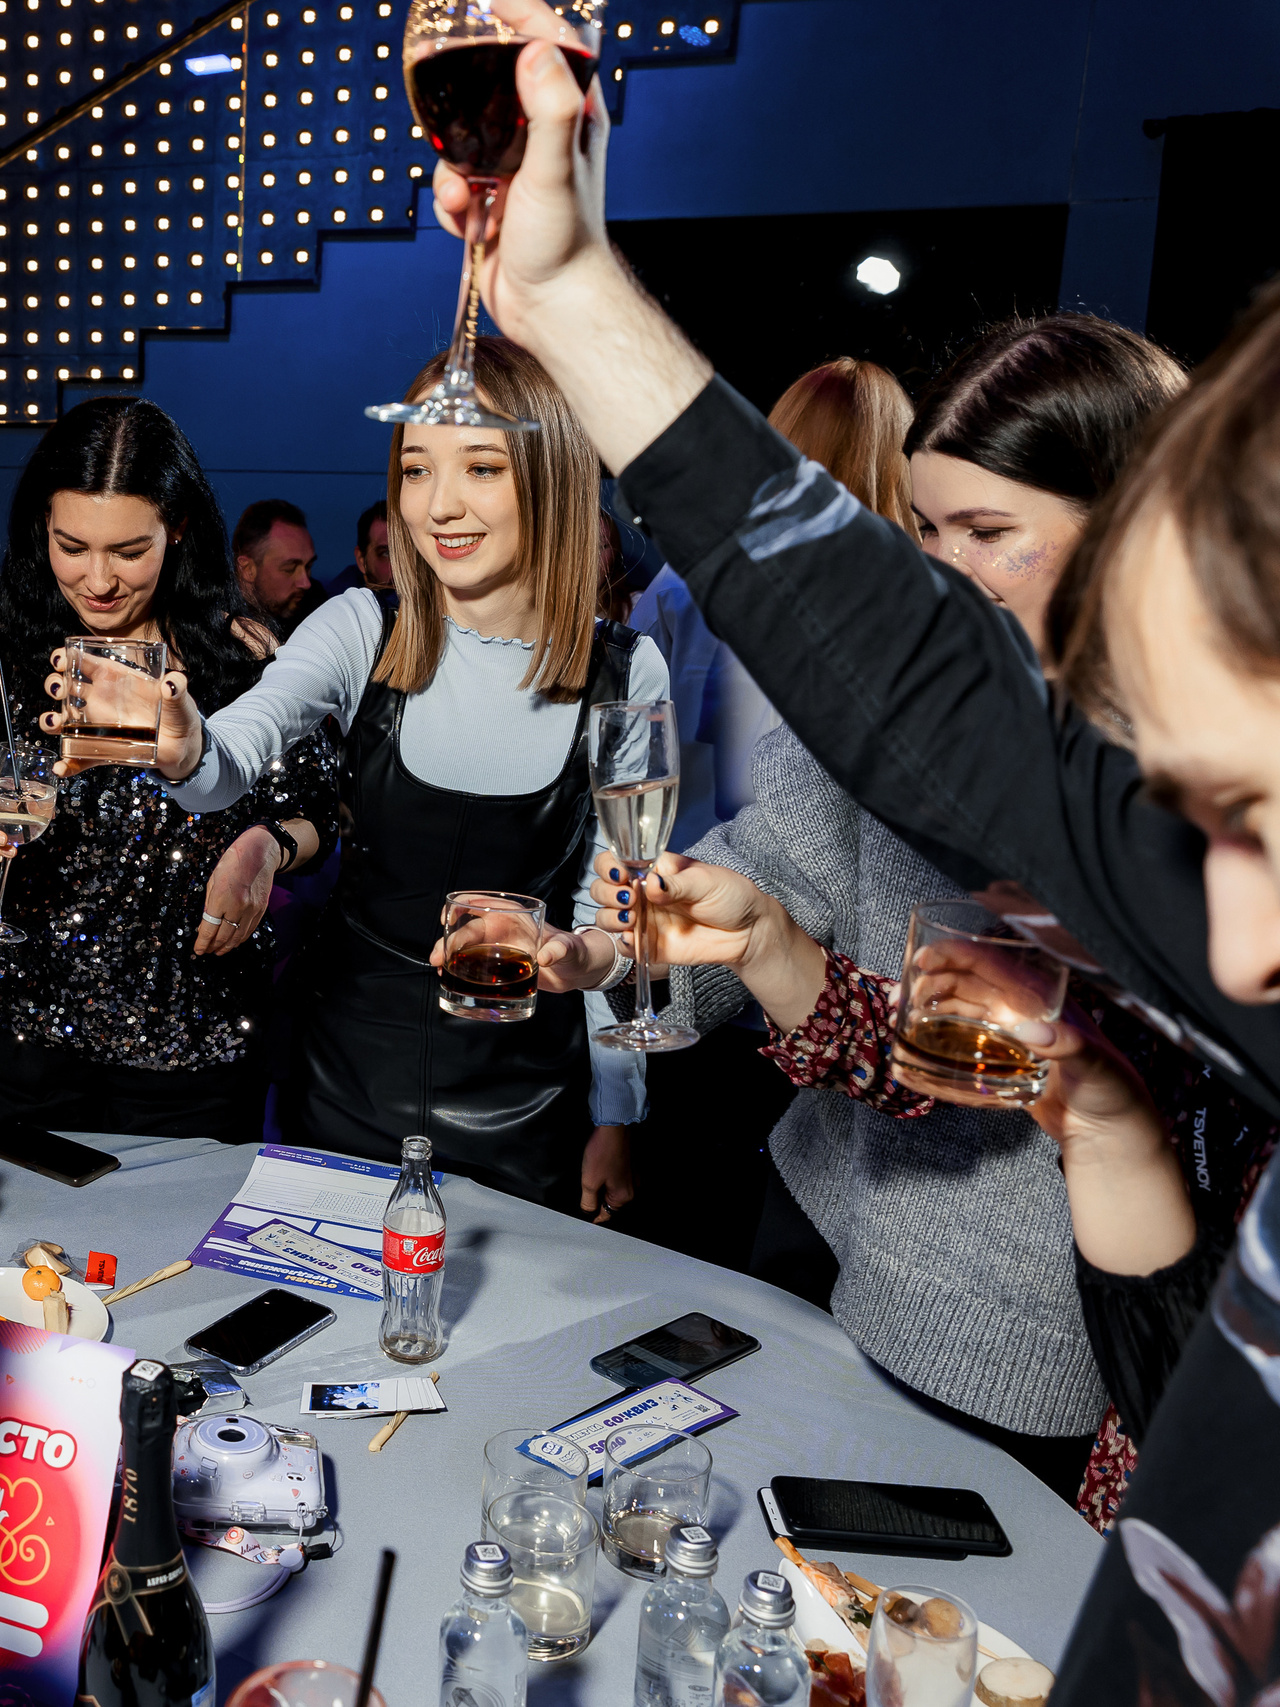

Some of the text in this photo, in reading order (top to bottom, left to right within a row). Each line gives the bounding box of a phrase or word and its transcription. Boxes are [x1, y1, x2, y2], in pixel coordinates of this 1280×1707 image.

[1193, 1107, 1211, 1192] TSVETNOY
[284, 1275, 338, 1289] ОТЗЫВЫ
[603, 1398, 659, 1428] GO!КВИЗ
[123, 1468, 138, 1524] 1870
